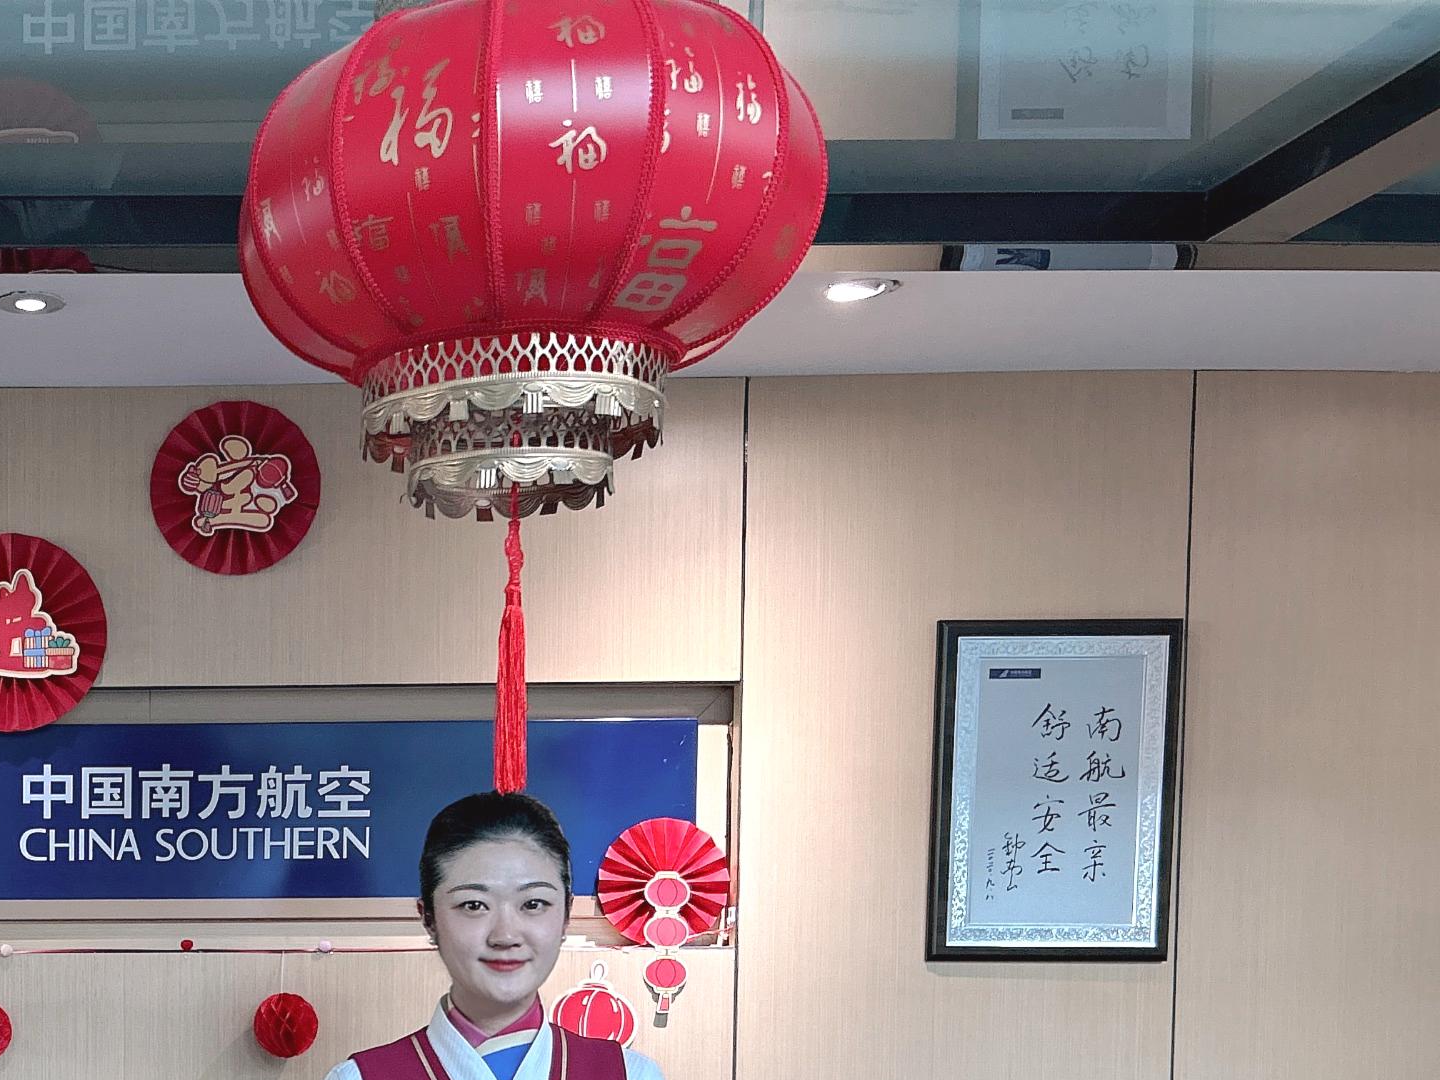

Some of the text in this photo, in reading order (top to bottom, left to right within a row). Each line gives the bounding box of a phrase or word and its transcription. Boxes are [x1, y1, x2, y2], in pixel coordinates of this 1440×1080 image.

[22, 763, 371, 820] 中国南方航空
[1031, 703, 1072, 874] 舒适安全
[19, 826, 371, 862] CHINA SOUTHERN
